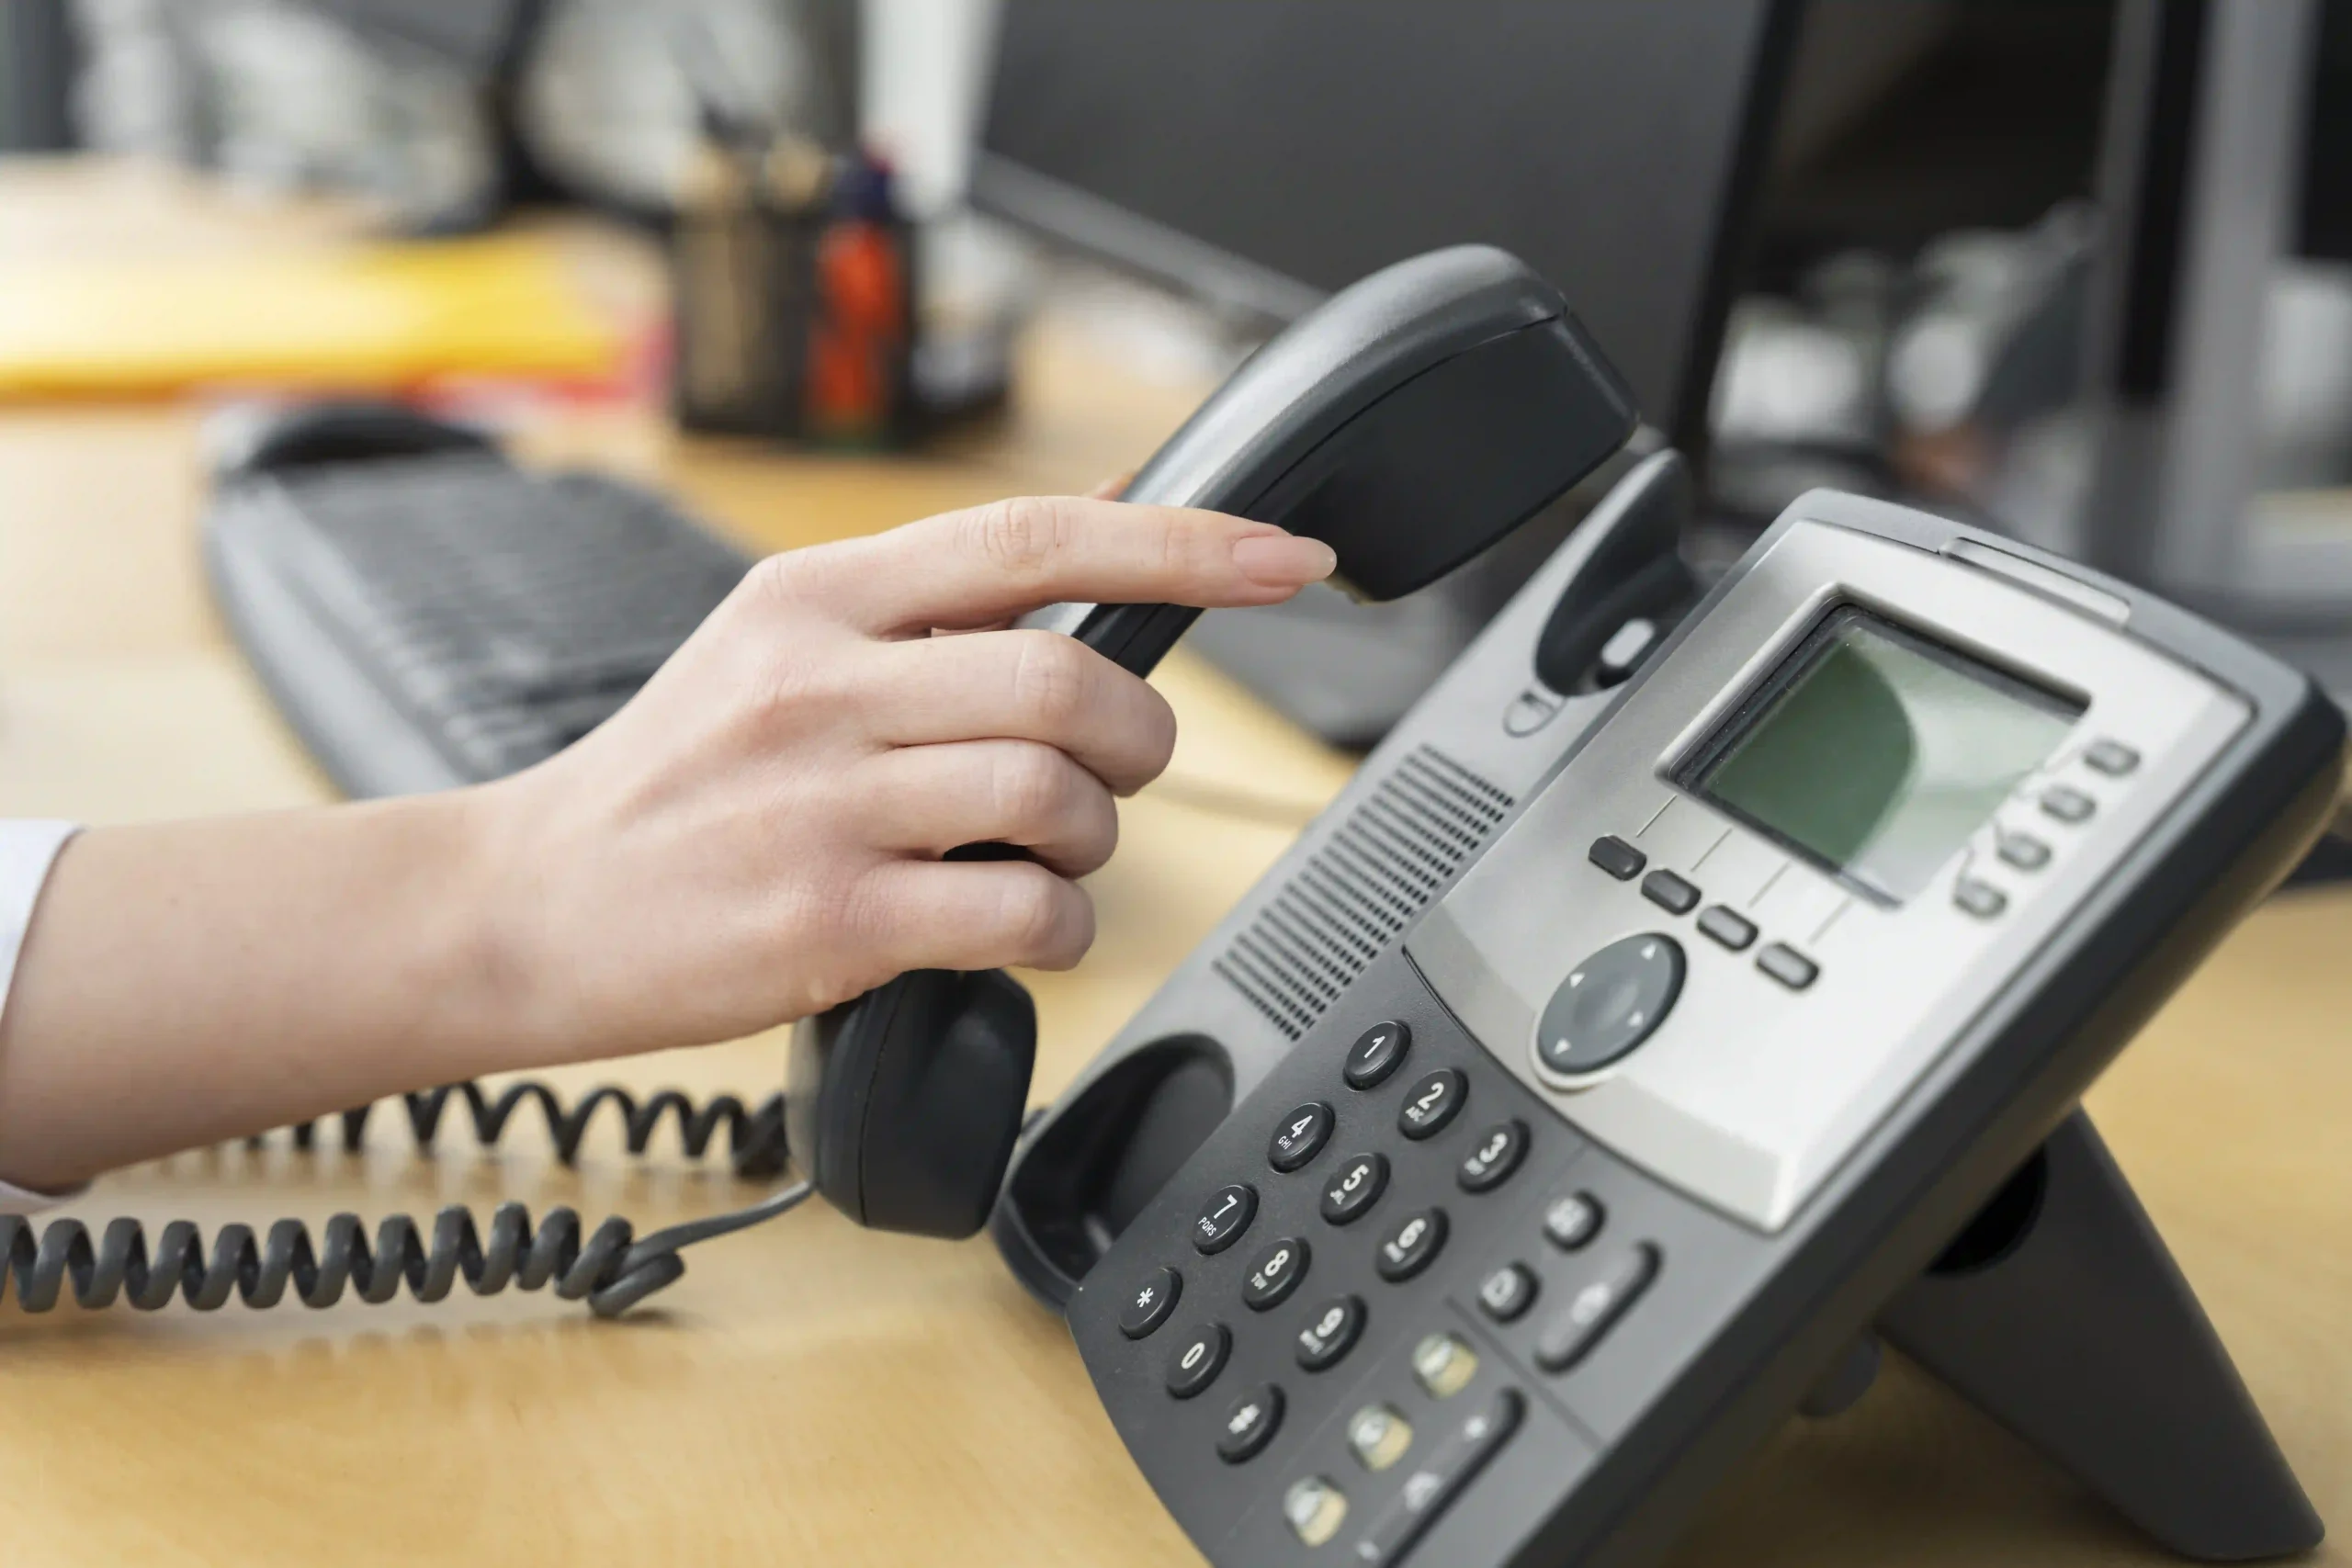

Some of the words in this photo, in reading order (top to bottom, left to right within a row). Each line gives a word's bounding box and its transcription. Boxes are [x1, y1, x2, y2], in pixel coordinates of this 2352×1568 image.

[1363, 1035, 1385, 1058] 1
[1417, 1081, 1443, 1111] 2
[1291, 1114, 1314, 1139] 4
[1277, 1134, 1293, 1150] GHI
[1479, 1132, 1509, 1163] 3
[1342, 1164, 1369, 1191] 5
[1213, 1193, 1238, 1219] 7
[1197, 1215, 1217, 1236] PQRS
[1397, 1217, 1427, 1248] 6
[1263, 1248, 1289, 1277] 8
[1316, 1306, 1344, 1337] 9
[1181, 1342, 1205, 1370] 0
